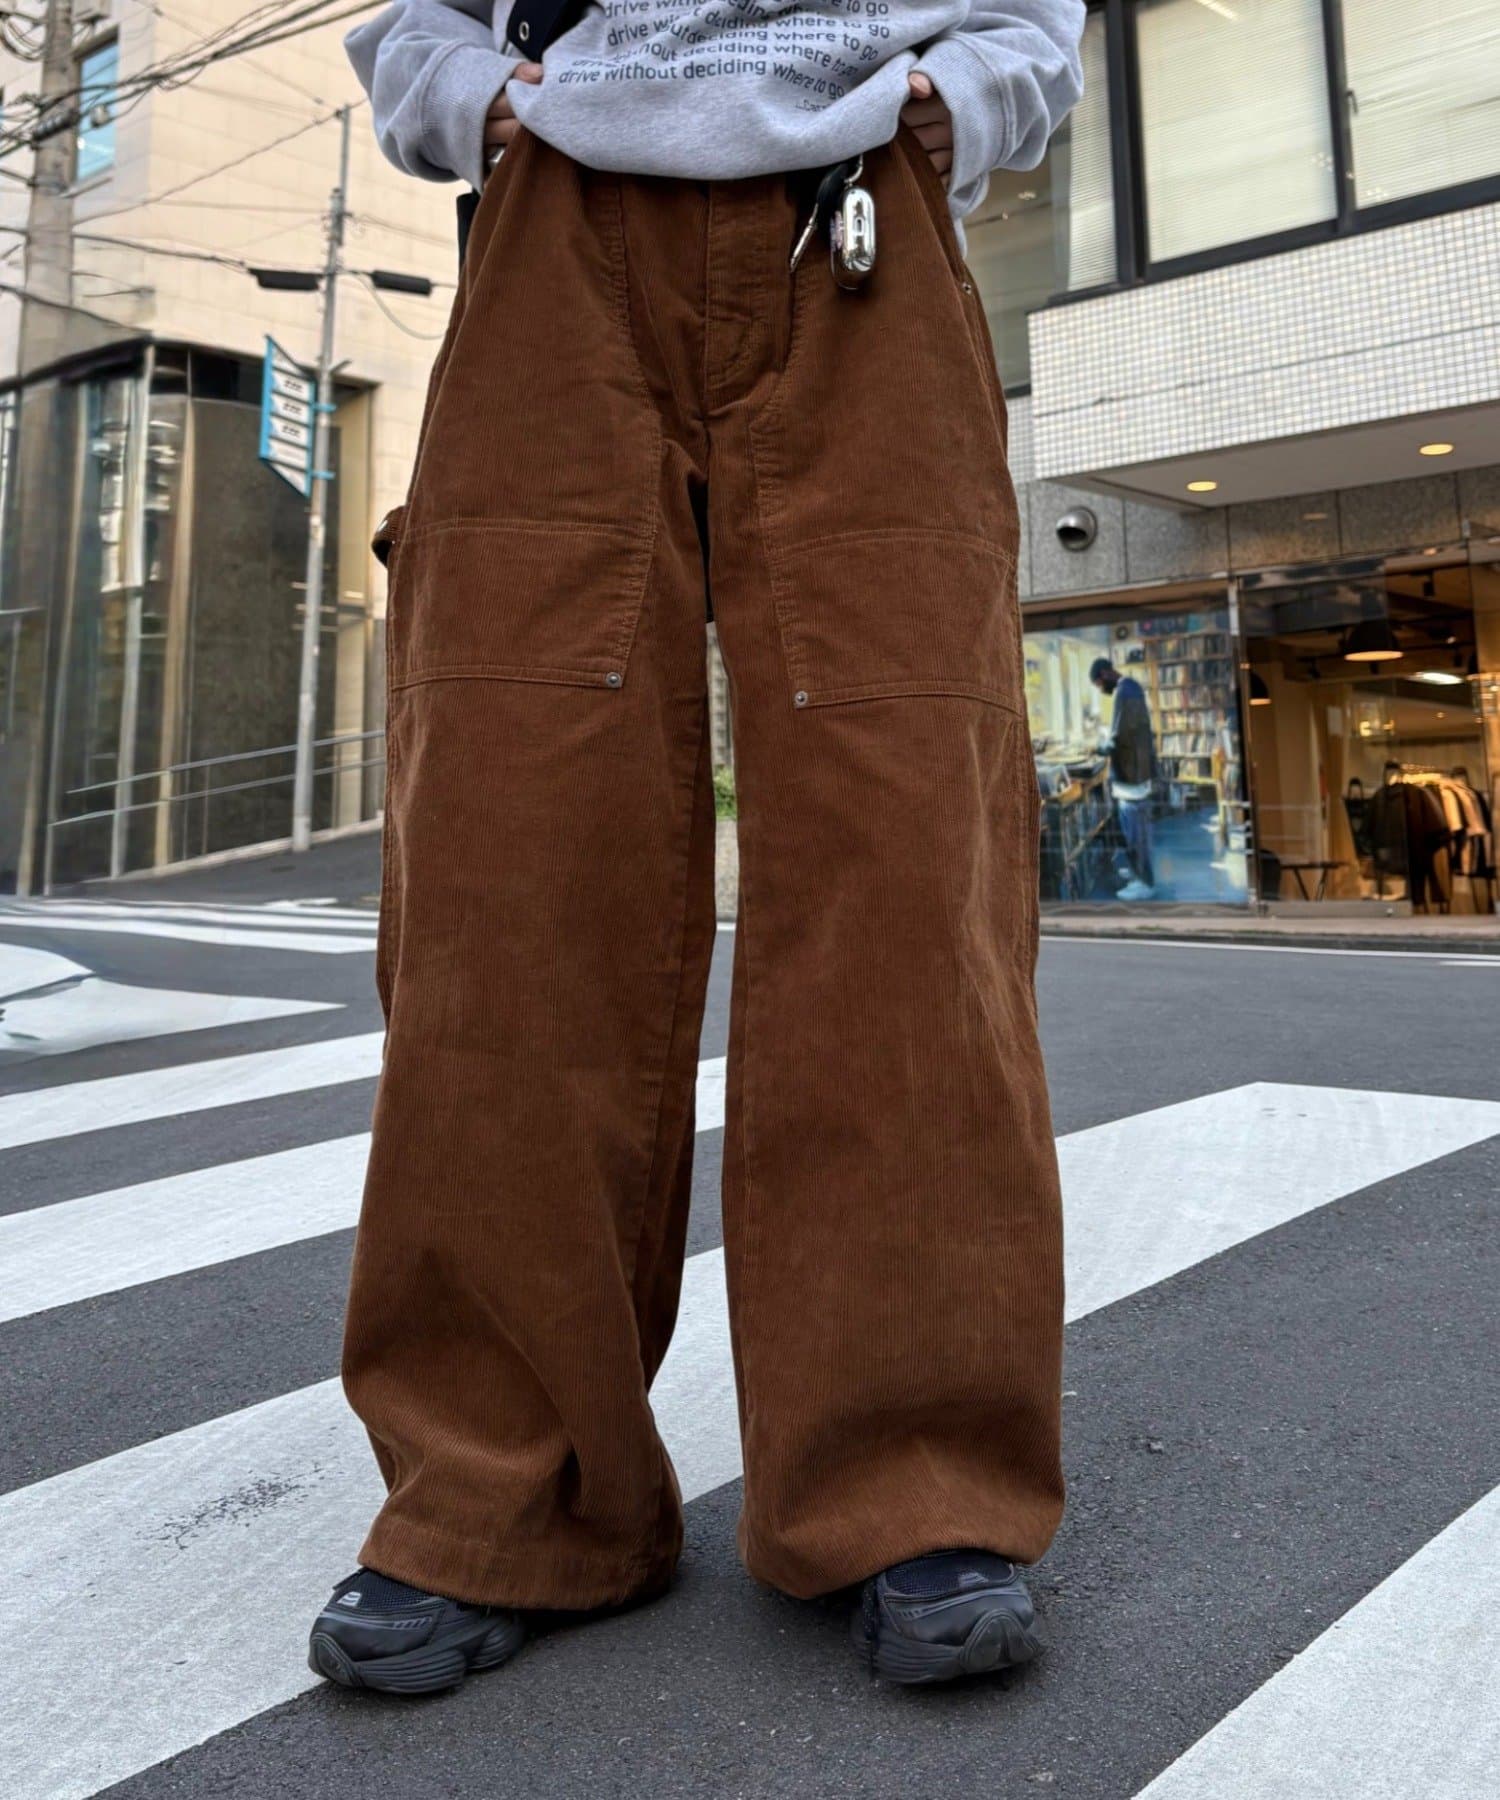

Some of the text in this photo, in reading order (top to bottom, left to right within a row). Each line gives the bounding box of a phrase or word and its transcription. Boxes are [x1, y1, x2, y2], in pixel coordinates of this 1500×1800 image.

[866, 1, 888, 17] go
[607, 23, 648, 46] drive
[775, 17, 836, 27] where
[868, 24, 889, 39] go
[683, 43, 768, 57] deciding
[774, 45, 832, 67] where
[774, 32, 836, 42] where
[843, 34, 860, 51] to
[859, 45, 879, 61] go
[559, 70, 600, 83] drive
[605, 62, 677, 80] without
[683, 59, 766, 79] deciding
[773, 62, 815, 88] where
[813, 78, 826, 93] to
[828, 82, 845, 100] go
